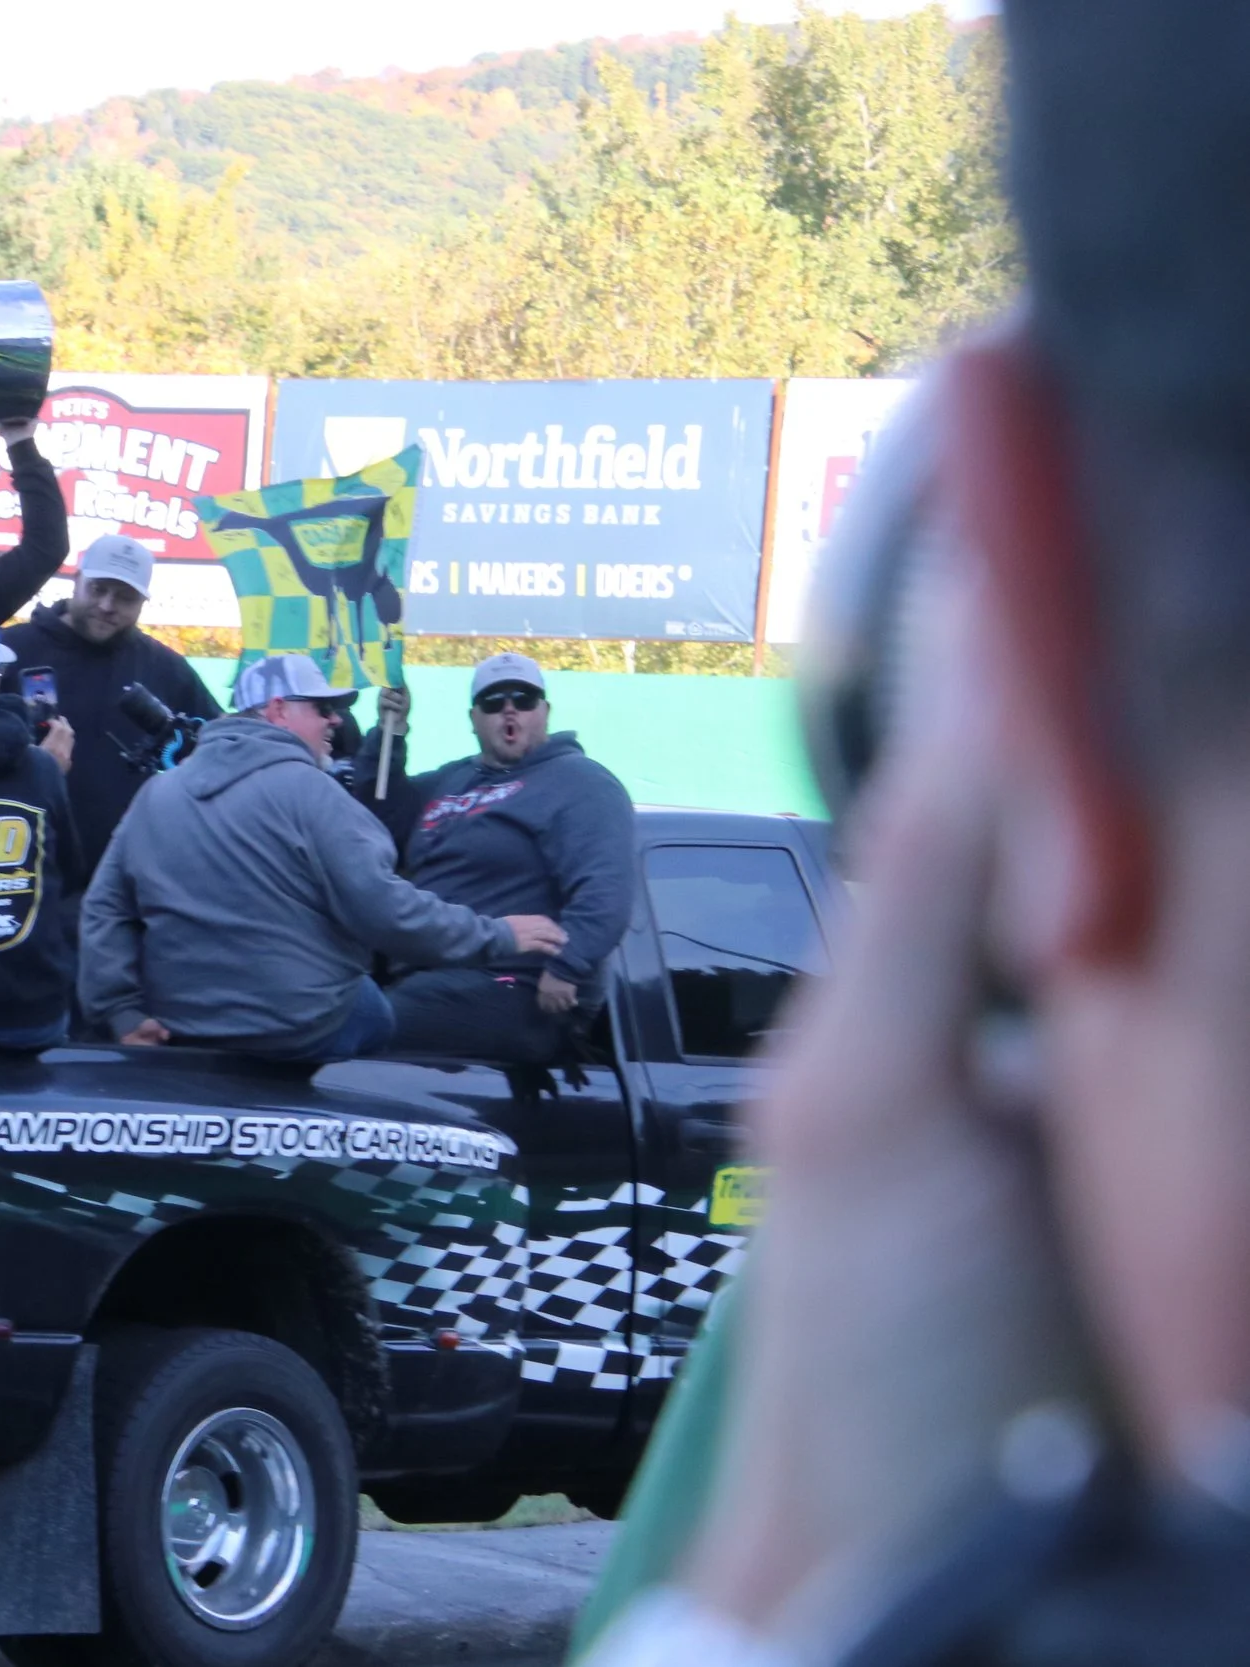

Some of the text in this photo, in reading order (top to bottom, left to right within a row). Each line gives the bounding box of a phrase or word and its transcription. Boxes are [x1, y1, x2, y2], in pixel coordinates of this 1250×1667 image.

[417, 424, 703, 491] Northfield
[73, 480, 199, 539] Rentals
[442, 503, 662, 526] SAVINGS BANK
[468, 562, 566, 597] MAKERS
[231, 1116, 344, 1157] STOCK
[347, 1121, 406, 1160] CAR
